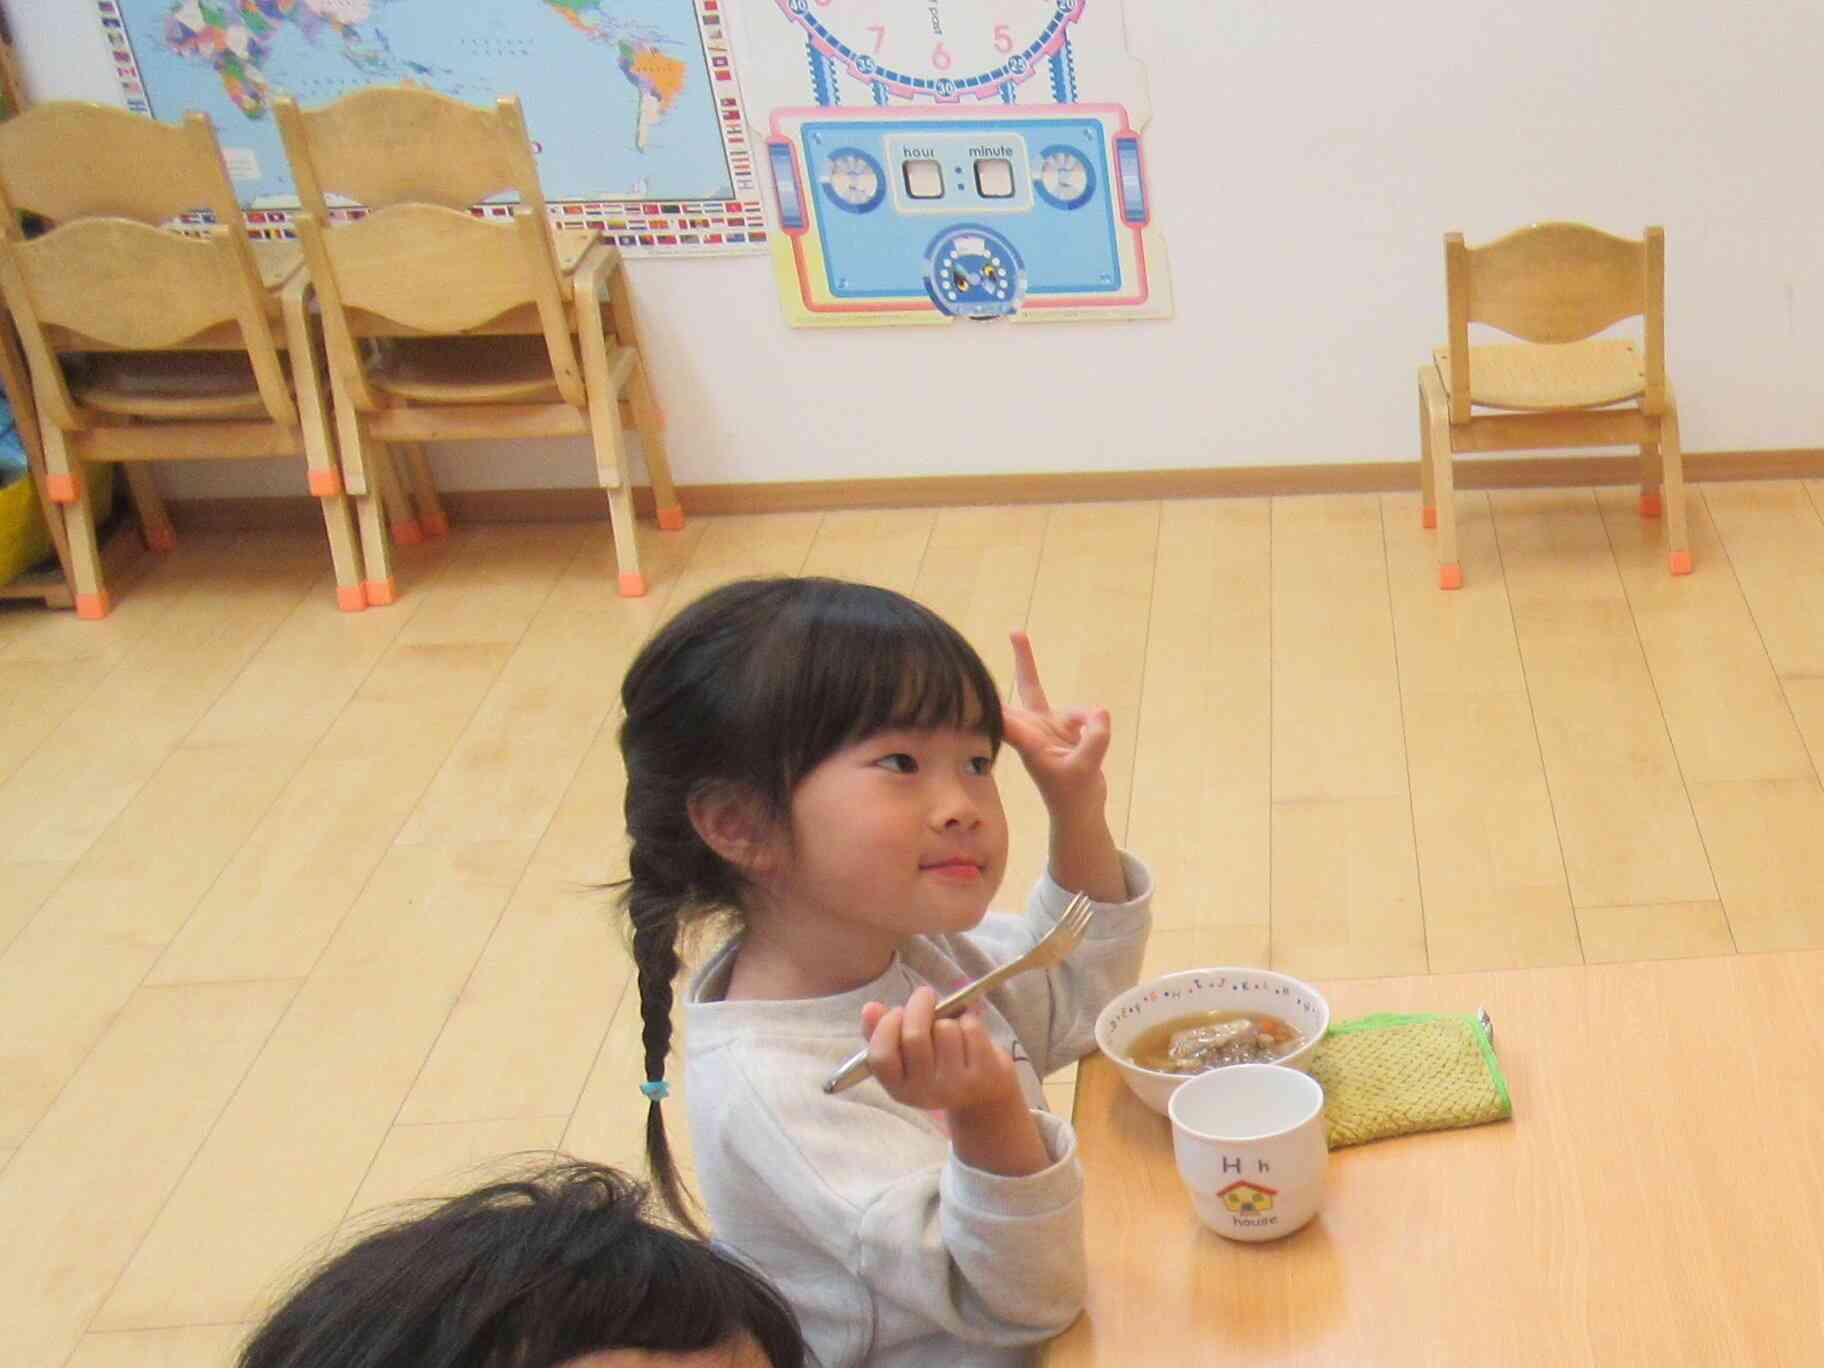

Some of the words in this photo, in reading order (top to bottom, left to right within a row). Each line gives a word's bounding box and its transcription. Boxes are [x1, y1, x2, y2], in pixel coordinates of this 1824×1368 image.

[865, 24, 885, 53] 7
[993, 24, 1013, 53] 5
[931, 42, 951, 71] 6
[903, 145, 936, 158] hour
[968, 145, 1014, 158] minute
[1222, 1155, 1241, 1174] H
[1232, 1215, 1279, 1227] house
